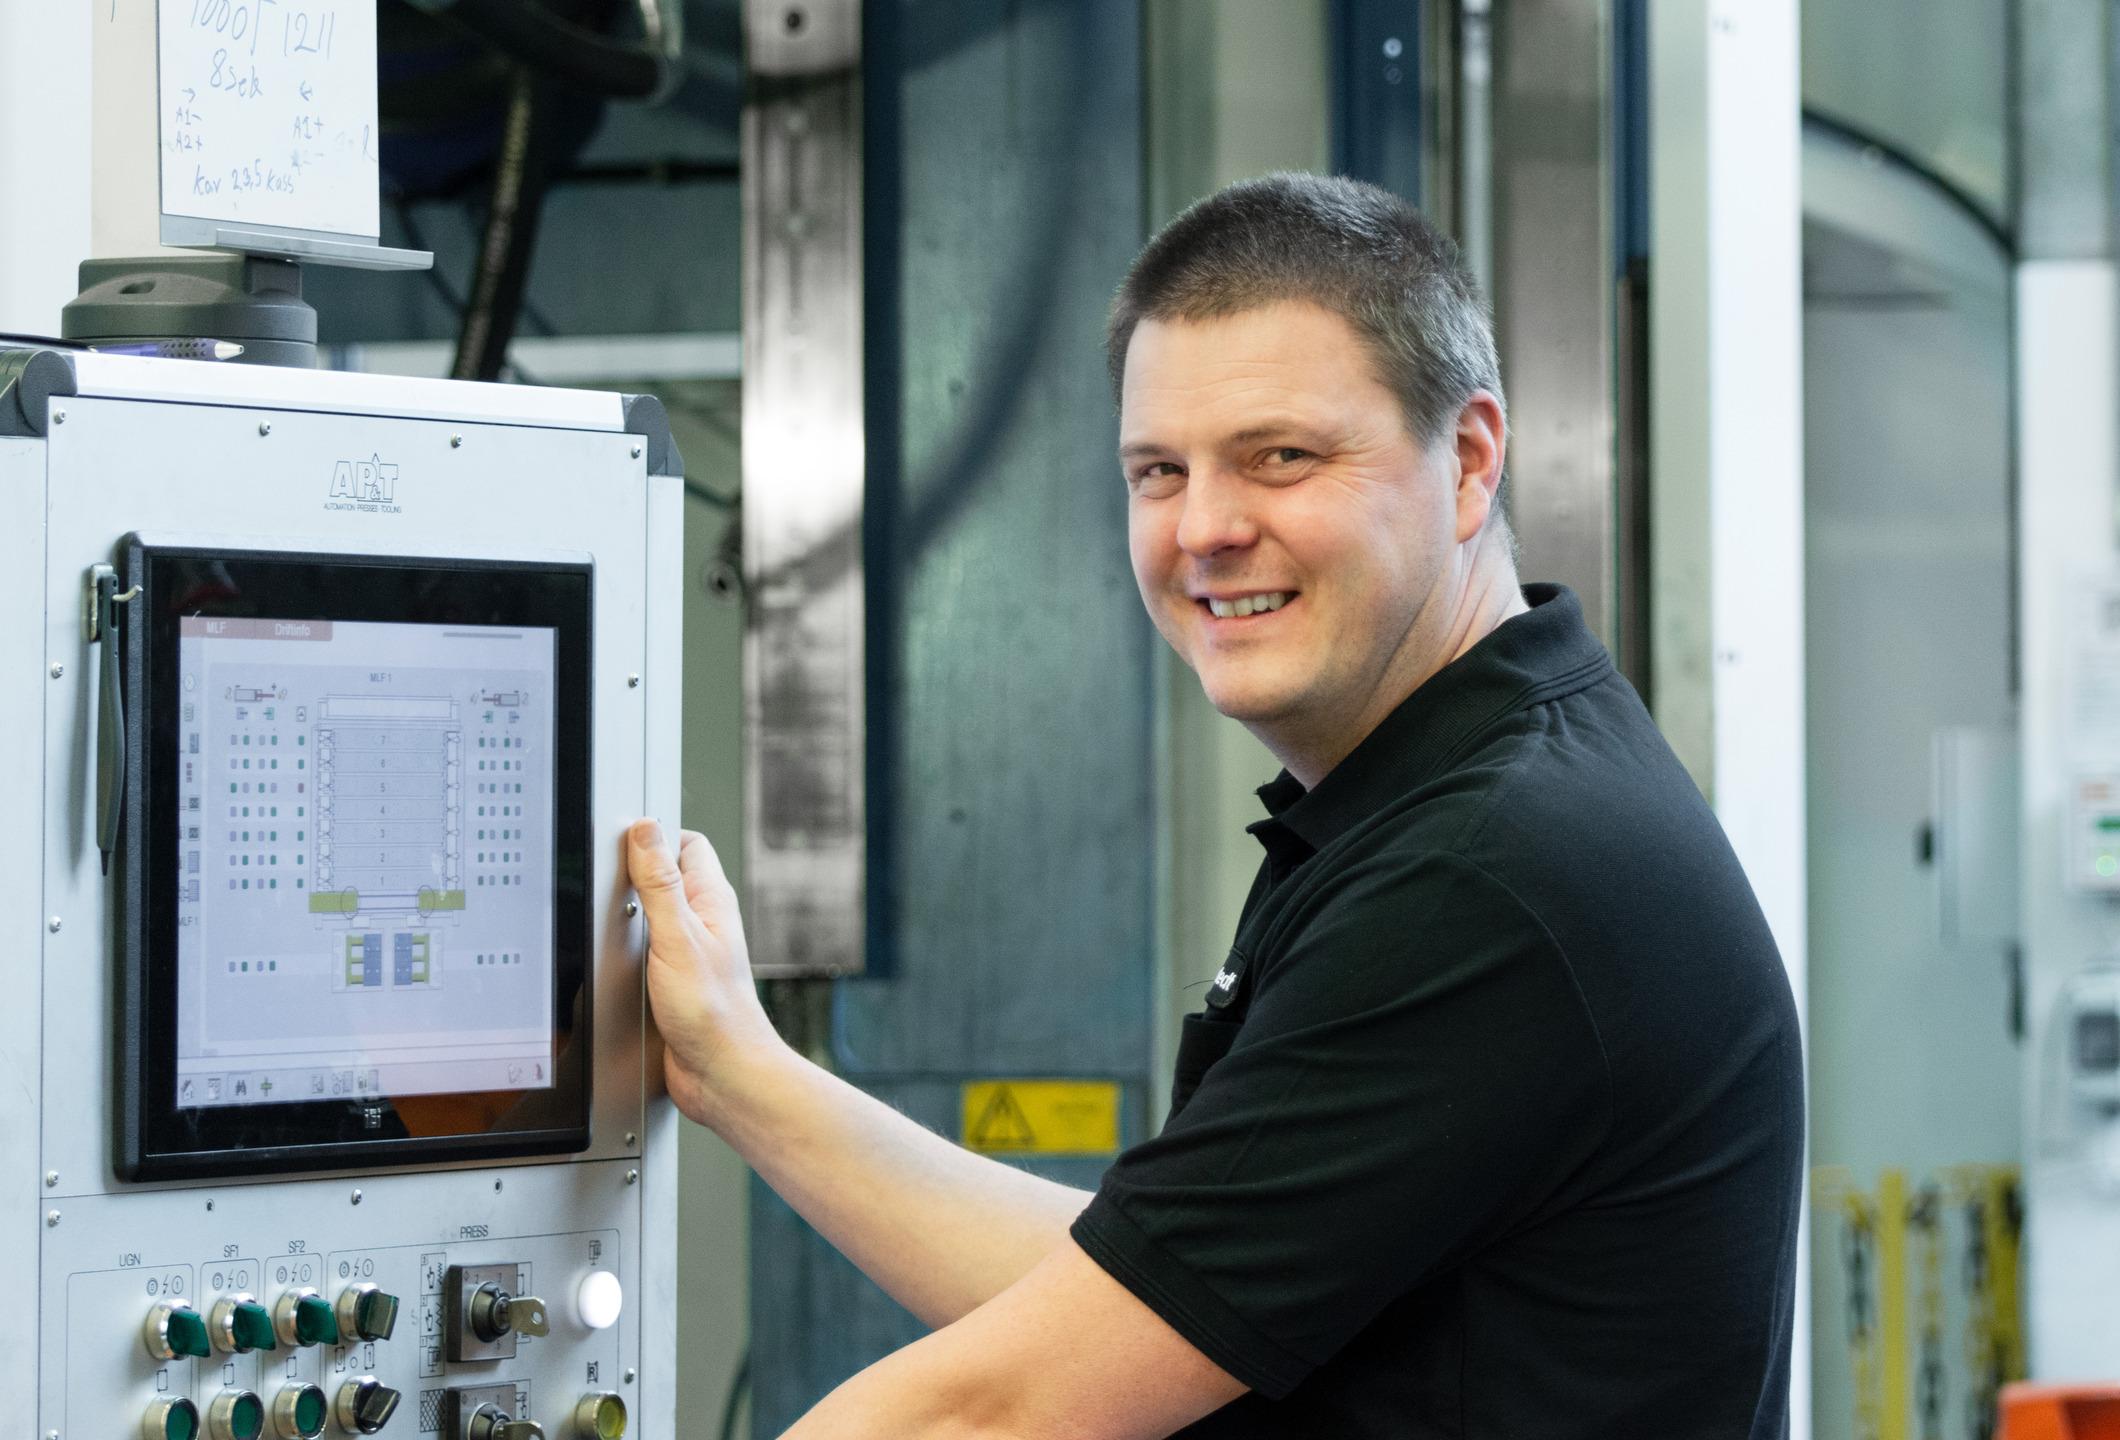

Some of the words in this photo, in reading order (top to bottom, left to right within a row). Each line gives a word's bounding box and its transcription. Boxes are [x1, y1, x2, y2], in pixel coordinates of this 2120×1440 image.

[206, 621, 227, 634] MLF
[274, 622, 311, 637] Driftinfo
[460, 1224, 489, 1239] PRESS
[223, 1244, 239, 1258] SF1
[288, 1239, 306, 1254] SF2
[119, 1253, 141, 1268] UGN
